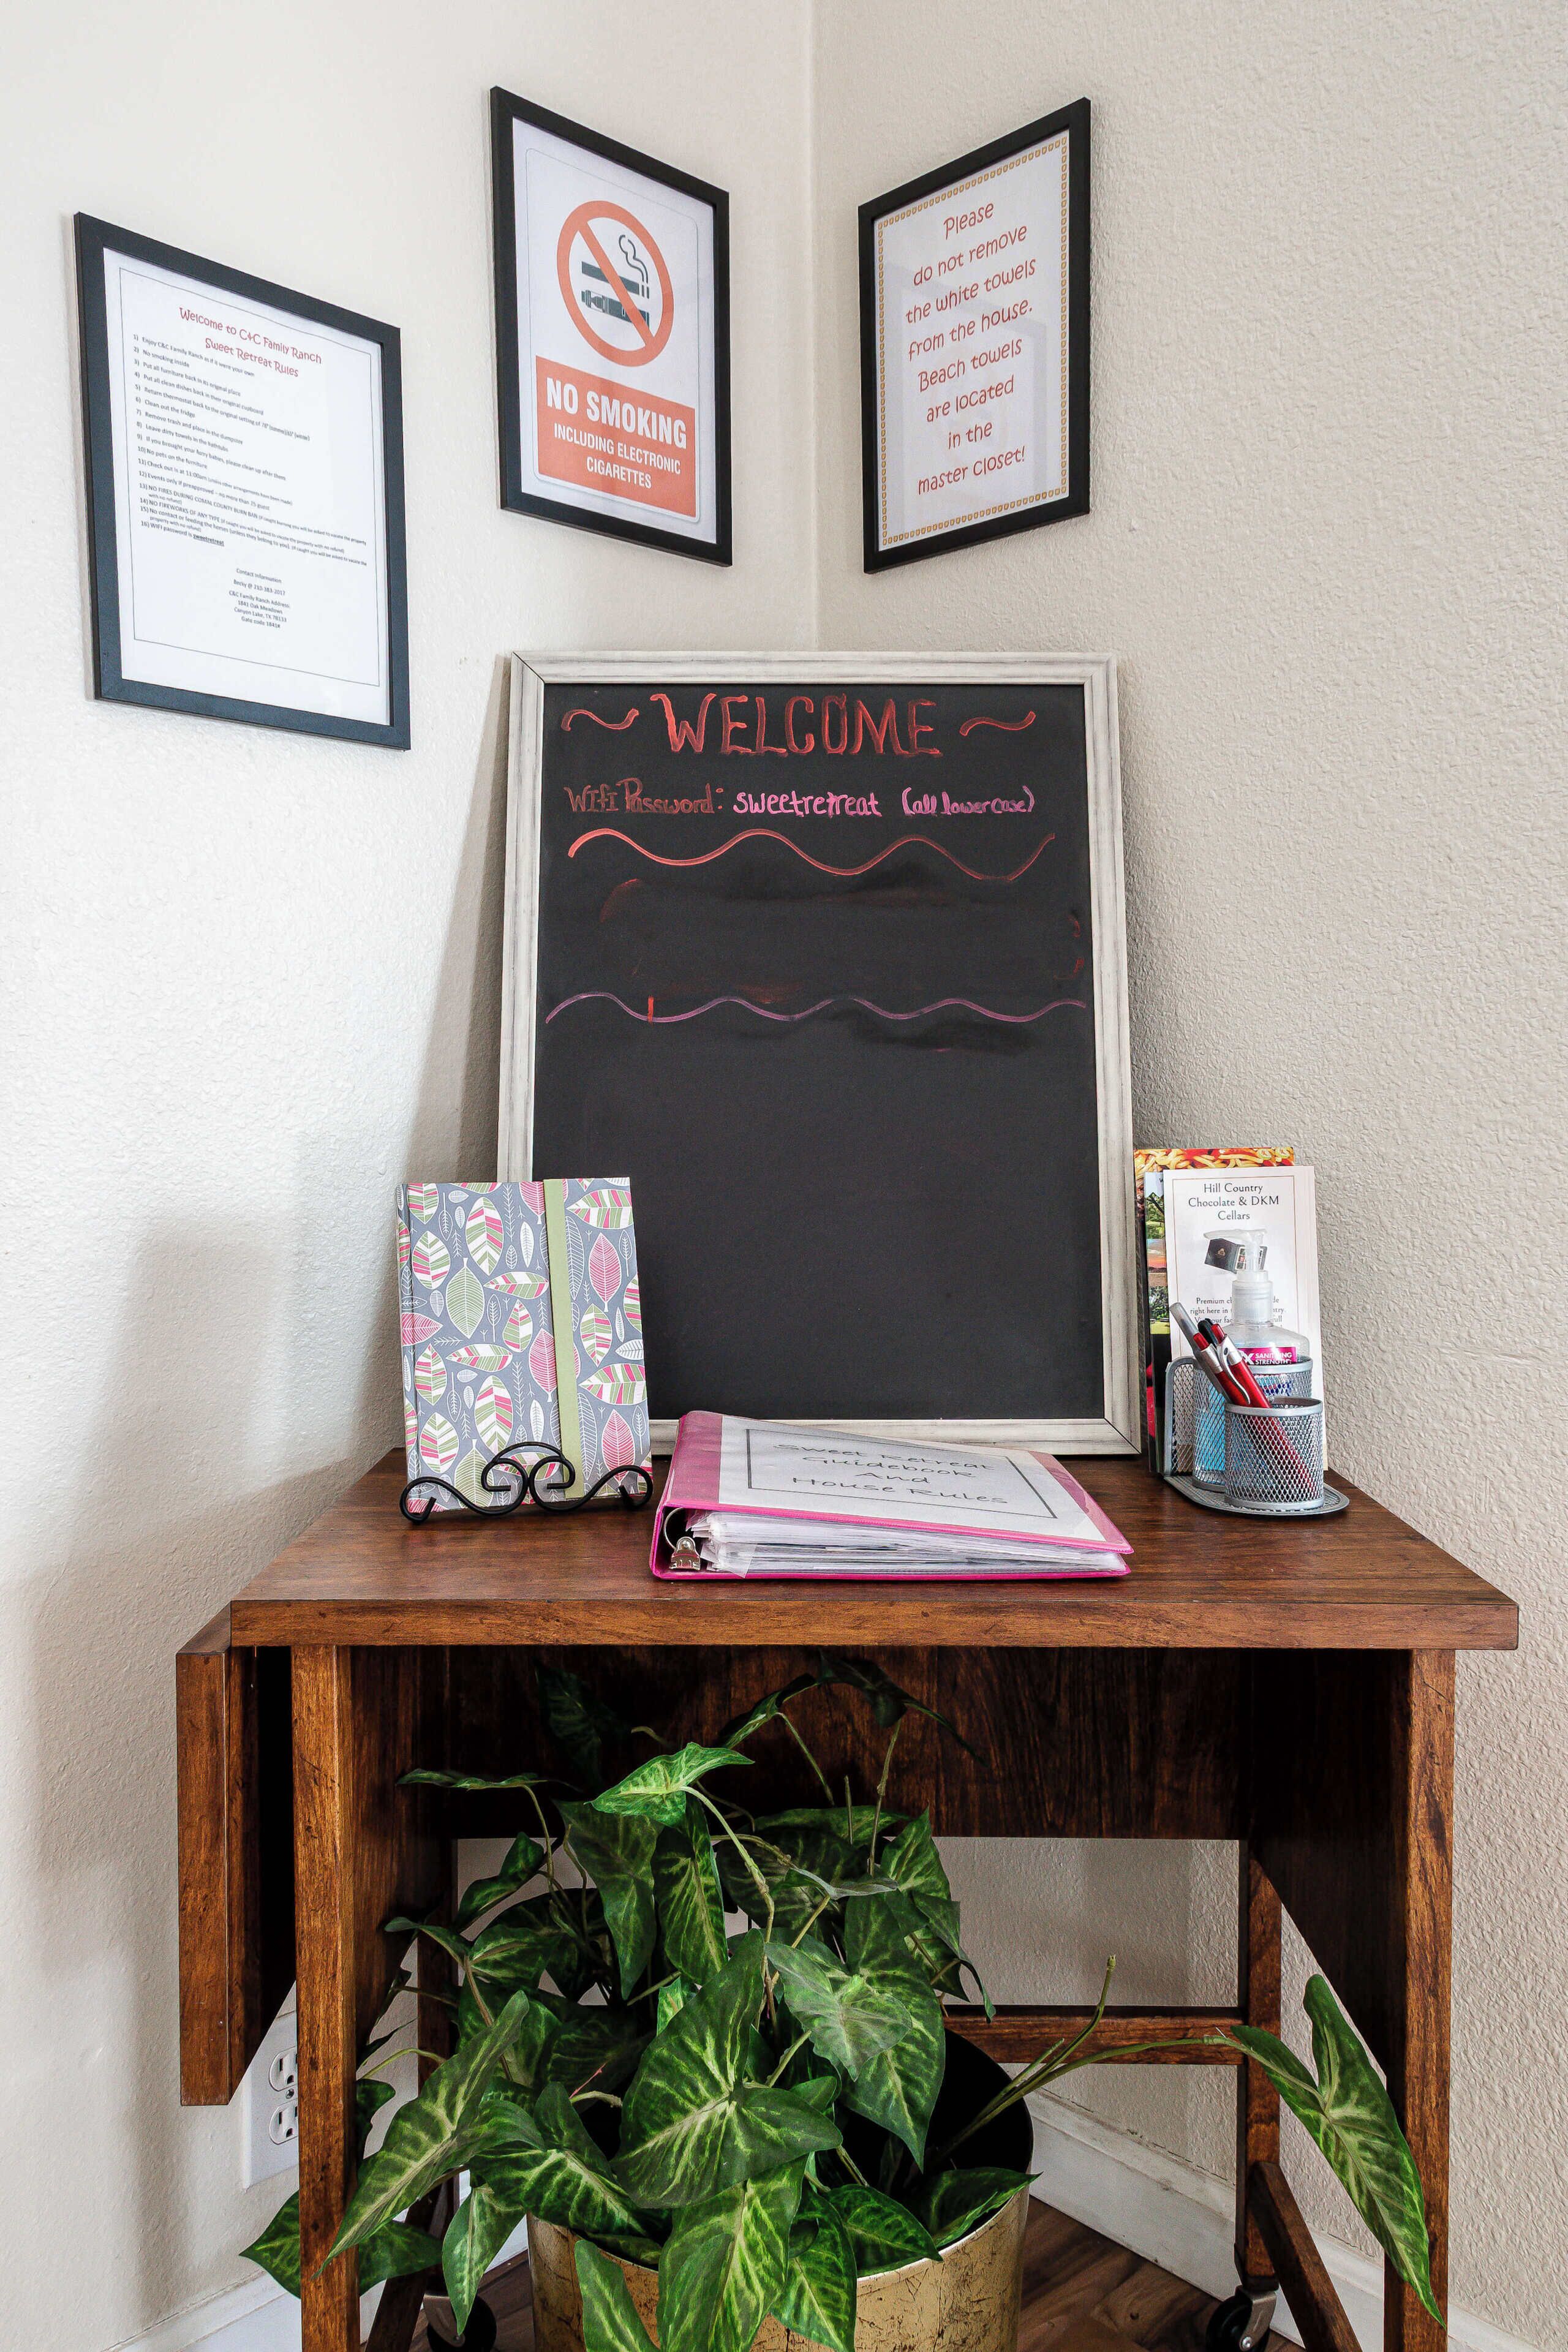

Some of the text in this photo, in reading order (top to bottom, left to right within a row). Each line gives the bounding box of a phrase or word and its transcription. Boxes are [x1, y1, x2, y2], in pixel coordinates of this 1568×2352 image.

[943, 203, 994, 240] Please
[913, 225, 1027, 286] do not remove
[905, 258, 1036, 323] the white towels
[179, 307, 223, 330] Welcome
[226, 325, 236, 334] to
[263, 337, 289, 354] Family
[291, 347, 322, 364] Ranch
[907, 299, 1032, 363] from the house.
[142, 337, 157, 347] Enjoy
[170, 345, 187, 355] Family
[188, 350, 203, 360] Ranch
[152, 353, 173, 364] smoking
[205, 339, 298, 377] Sweet Retreat Rules
[185, 374, 196, 382] back
[918, 338, 1022, 393] Beach towels
[546, 377, 687, 449] NO SMOKING
[927, 374, 1014, 423] are located
[554, 423, 681, 475] INCLUDING ELECTRONIC
[949, 422, 992, 450] in the
[586, 456, 652, 489] CIGARETTES
[918, 466, 968, 495] master
[649, 693, 944, 757] WELCOME
[733, 790, 883, 818] sweetretreat
[902, 786, 938, 816] (all
[1188, 1196, 1279, 1207] Chocolate & DKM
[1204, 1183, 1263, 1194] Hill Country
[1218, 1210, 1250, 1220] Cellars
[773, 1444, 995, 1471] Sweet Retreat
[802, 1456, 976, 1479] Guidebook
[793, 1477, 1008, 1504] House Rules
[855, 1472, 931, 1484] And
